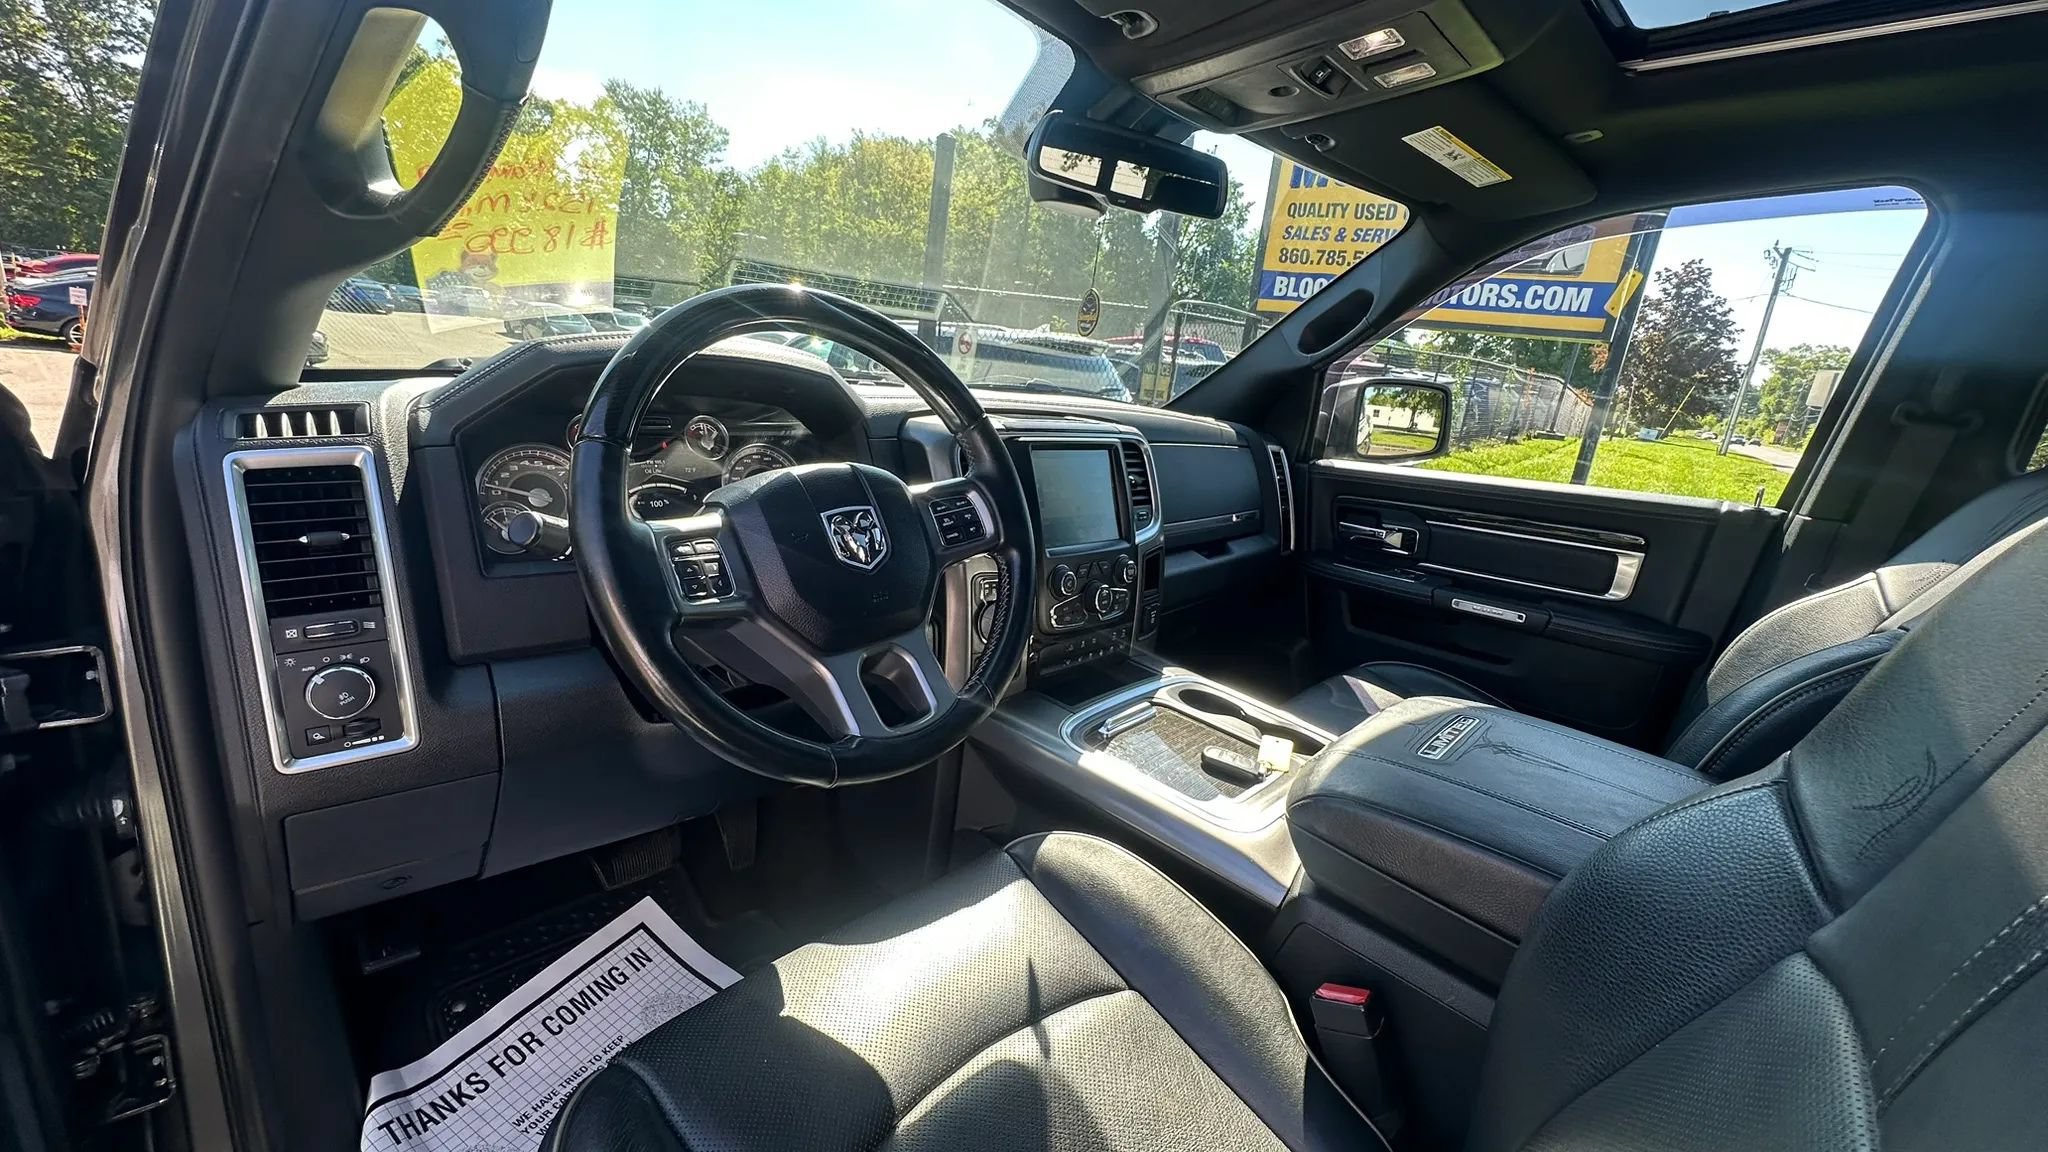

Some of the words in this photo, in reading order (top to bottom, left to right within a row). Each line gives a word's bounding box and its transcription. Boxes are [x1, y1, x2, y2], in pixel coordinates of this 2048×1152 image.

[1287, 202, 1350, 219] QUALITY
[1354, 203, 1398, 221] USED
[1282, 225, 1332, 241] SALES
[1333, 227, 1348, 243] &
[1351, 228, 1400, 244] SERV
[1278, 248, 1369, 267] 860.785.5
[339, 696, 355, 706] PUSH
[377, 1071, 491, 1146] THANKS
[487, 1031, 545, 1079] FOR
[541, 965, 630, 1036] COMING
[624, 946, 653, 973] IN
[512, 1110, 533, 1128] WE
[531, 1088, 560, 1113] HAVE
[558, 1065, 589, 1090] TRIED
[587, 1054, 603, 1067] TO
[601, 1035, 624, 1056] KEEP
[520, 1109, 554, 1136] YOUR
